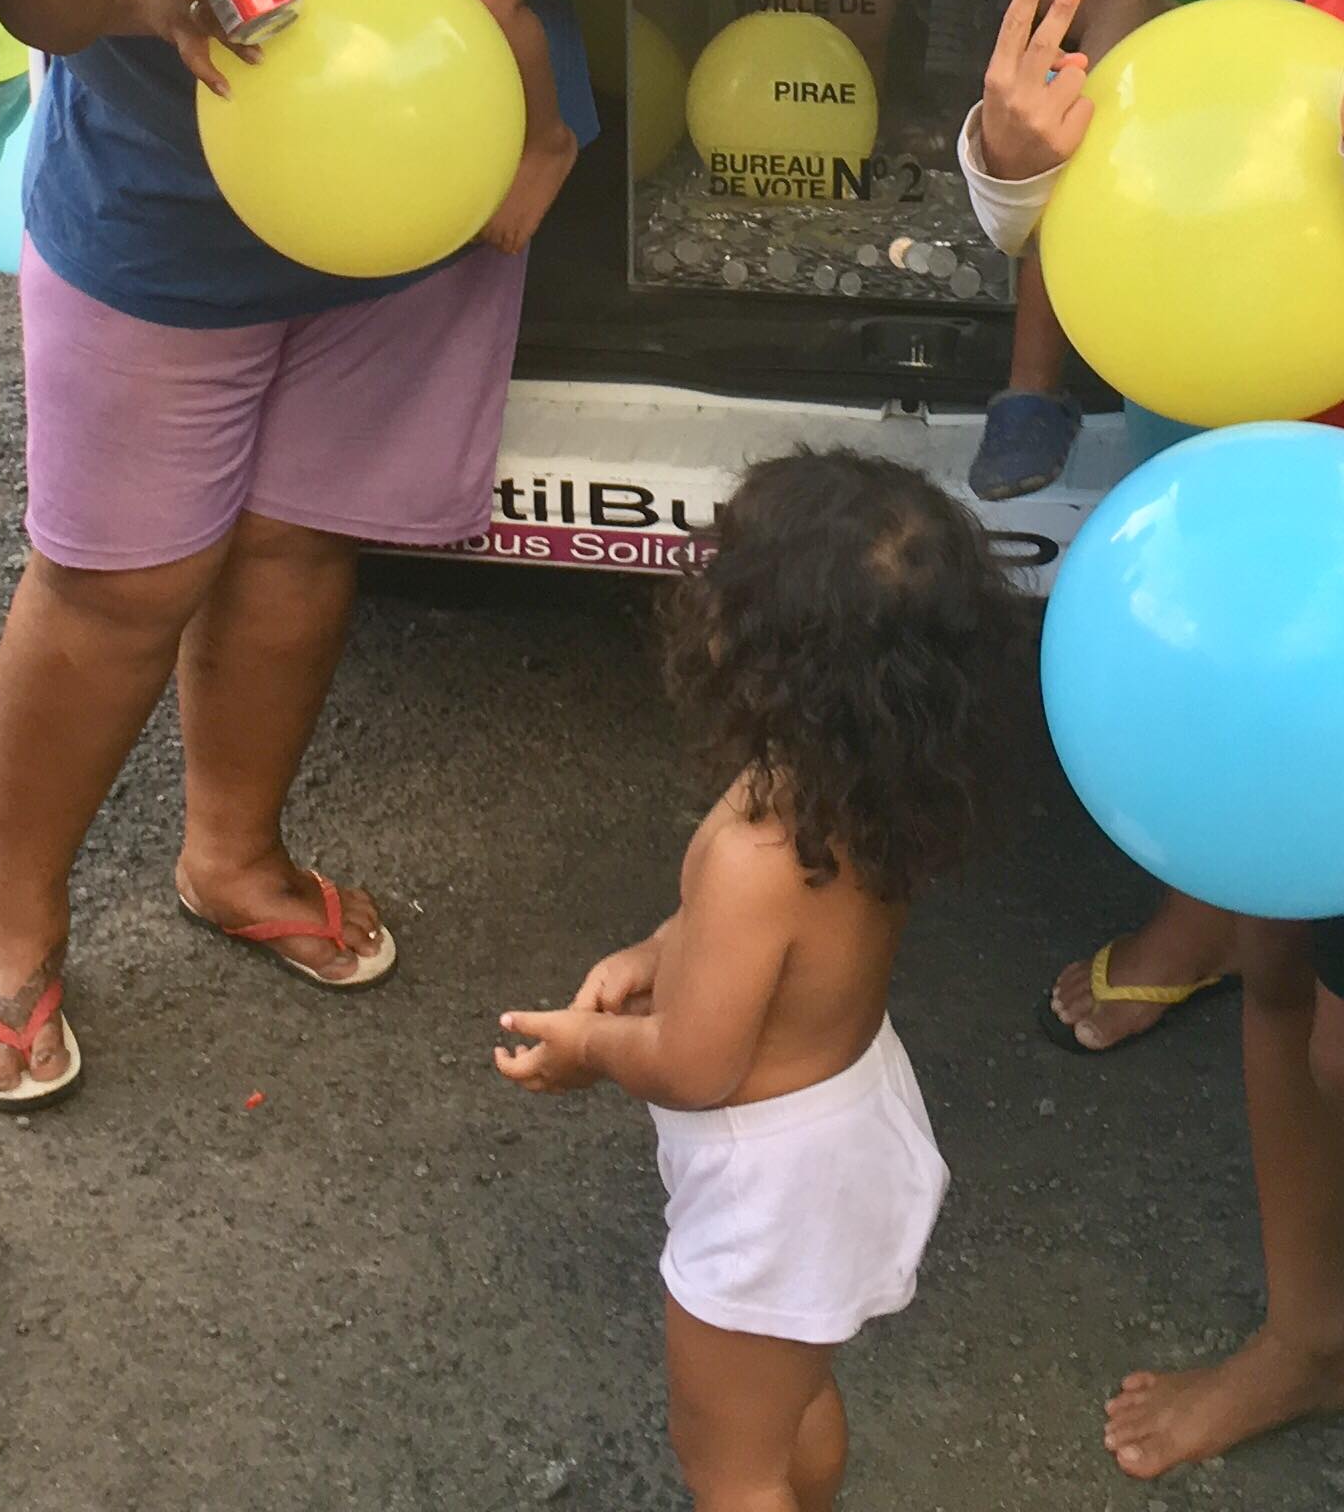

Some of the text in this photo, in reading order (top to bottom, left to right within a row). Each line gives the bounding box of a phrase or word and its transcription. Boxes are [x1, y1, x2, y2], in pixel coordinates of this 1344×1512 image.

[773, 80, 856, 105] PIRAE
[710, 152, 825, 178] BUREAU
[709, 176, 826, 200] DE VOTE
[494, 477, 729, 532] tilBu
